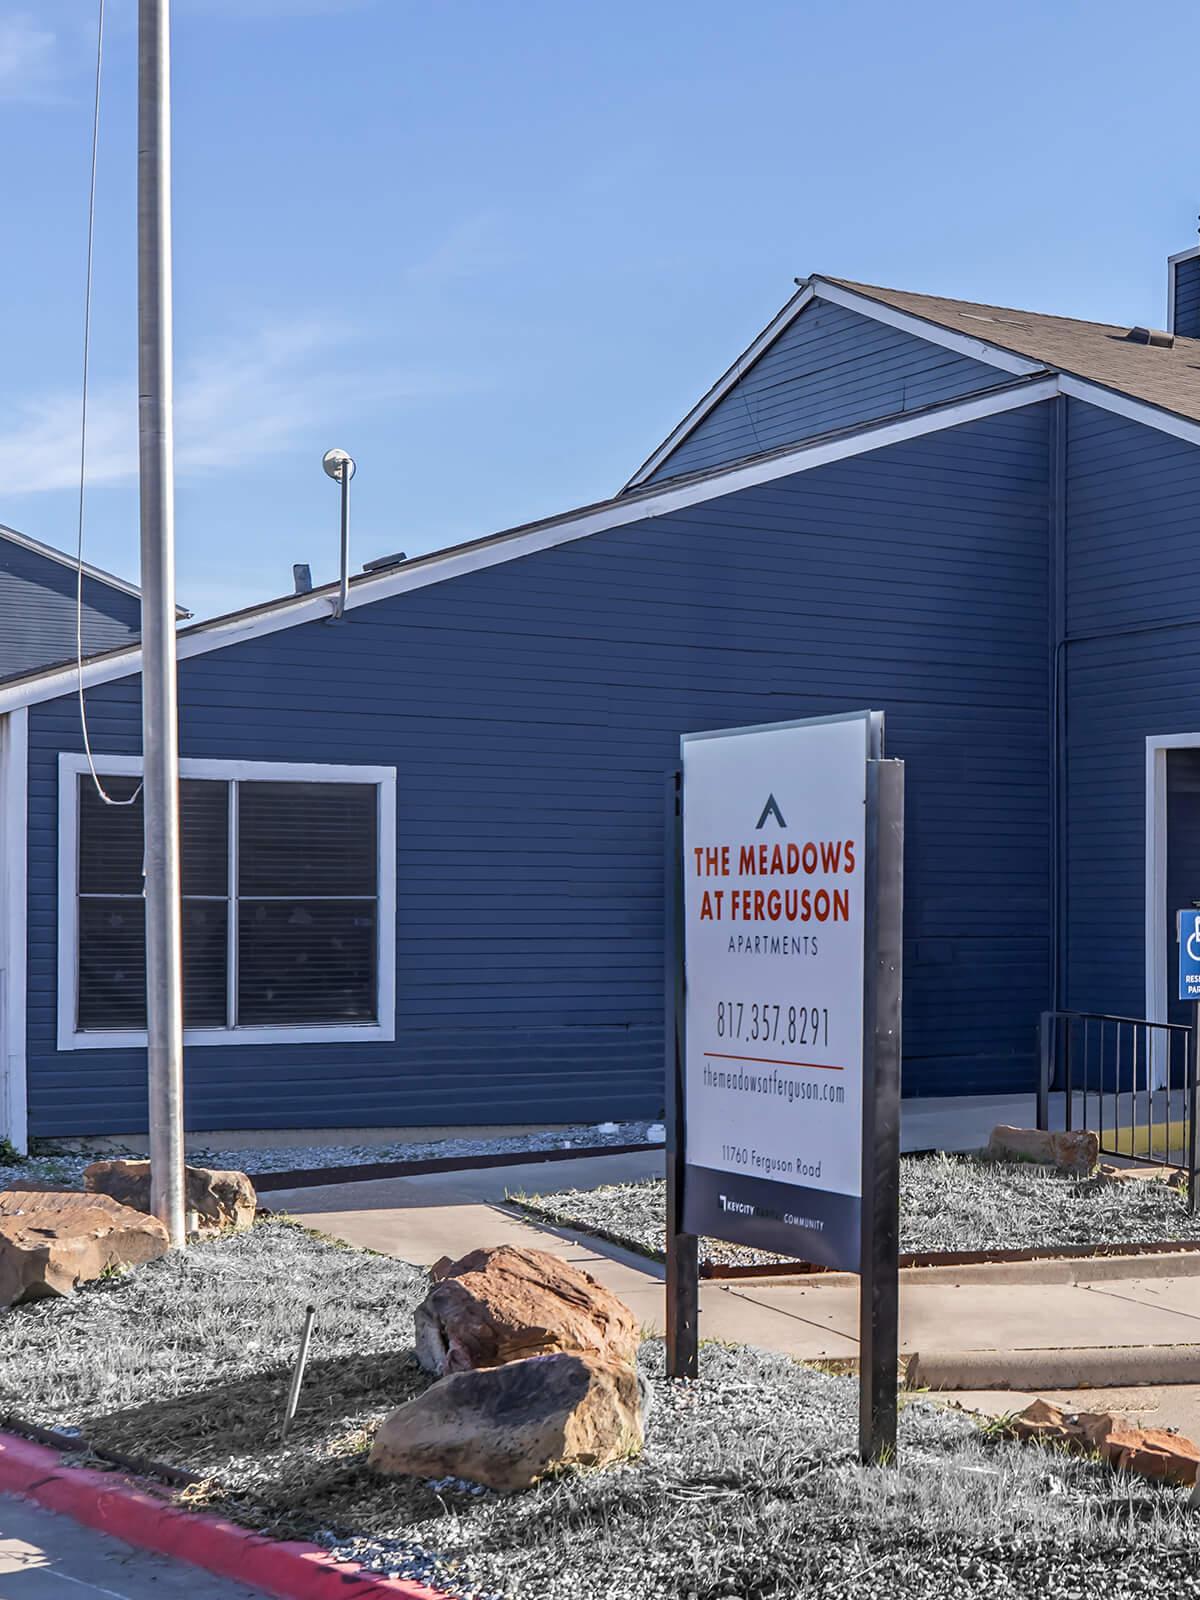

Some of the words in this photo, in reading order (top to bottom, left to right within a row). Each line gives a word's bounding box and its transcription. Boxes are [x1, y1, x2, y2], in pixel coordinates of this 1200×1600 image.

[694, 847, 730, 876] THE
[738, 840, 855, 875] MEADOWS
[700, 890, 724, 921] AT
[731, 889, 849, 922] FERGUSON
[728, 935, 819, 955] APARTMENTS
[717, 1001, 829, 1047] 817.357.8291
[703, 1063, 845, 1104] themeadowsatferguson.com
[722, 1144, 748, 1165] 11760
[751, 1150, 793, 1174] Ferguson
[796, 1158, 822, 1178] Road
[783, 1213, 824, 1231] COMMUNITY
